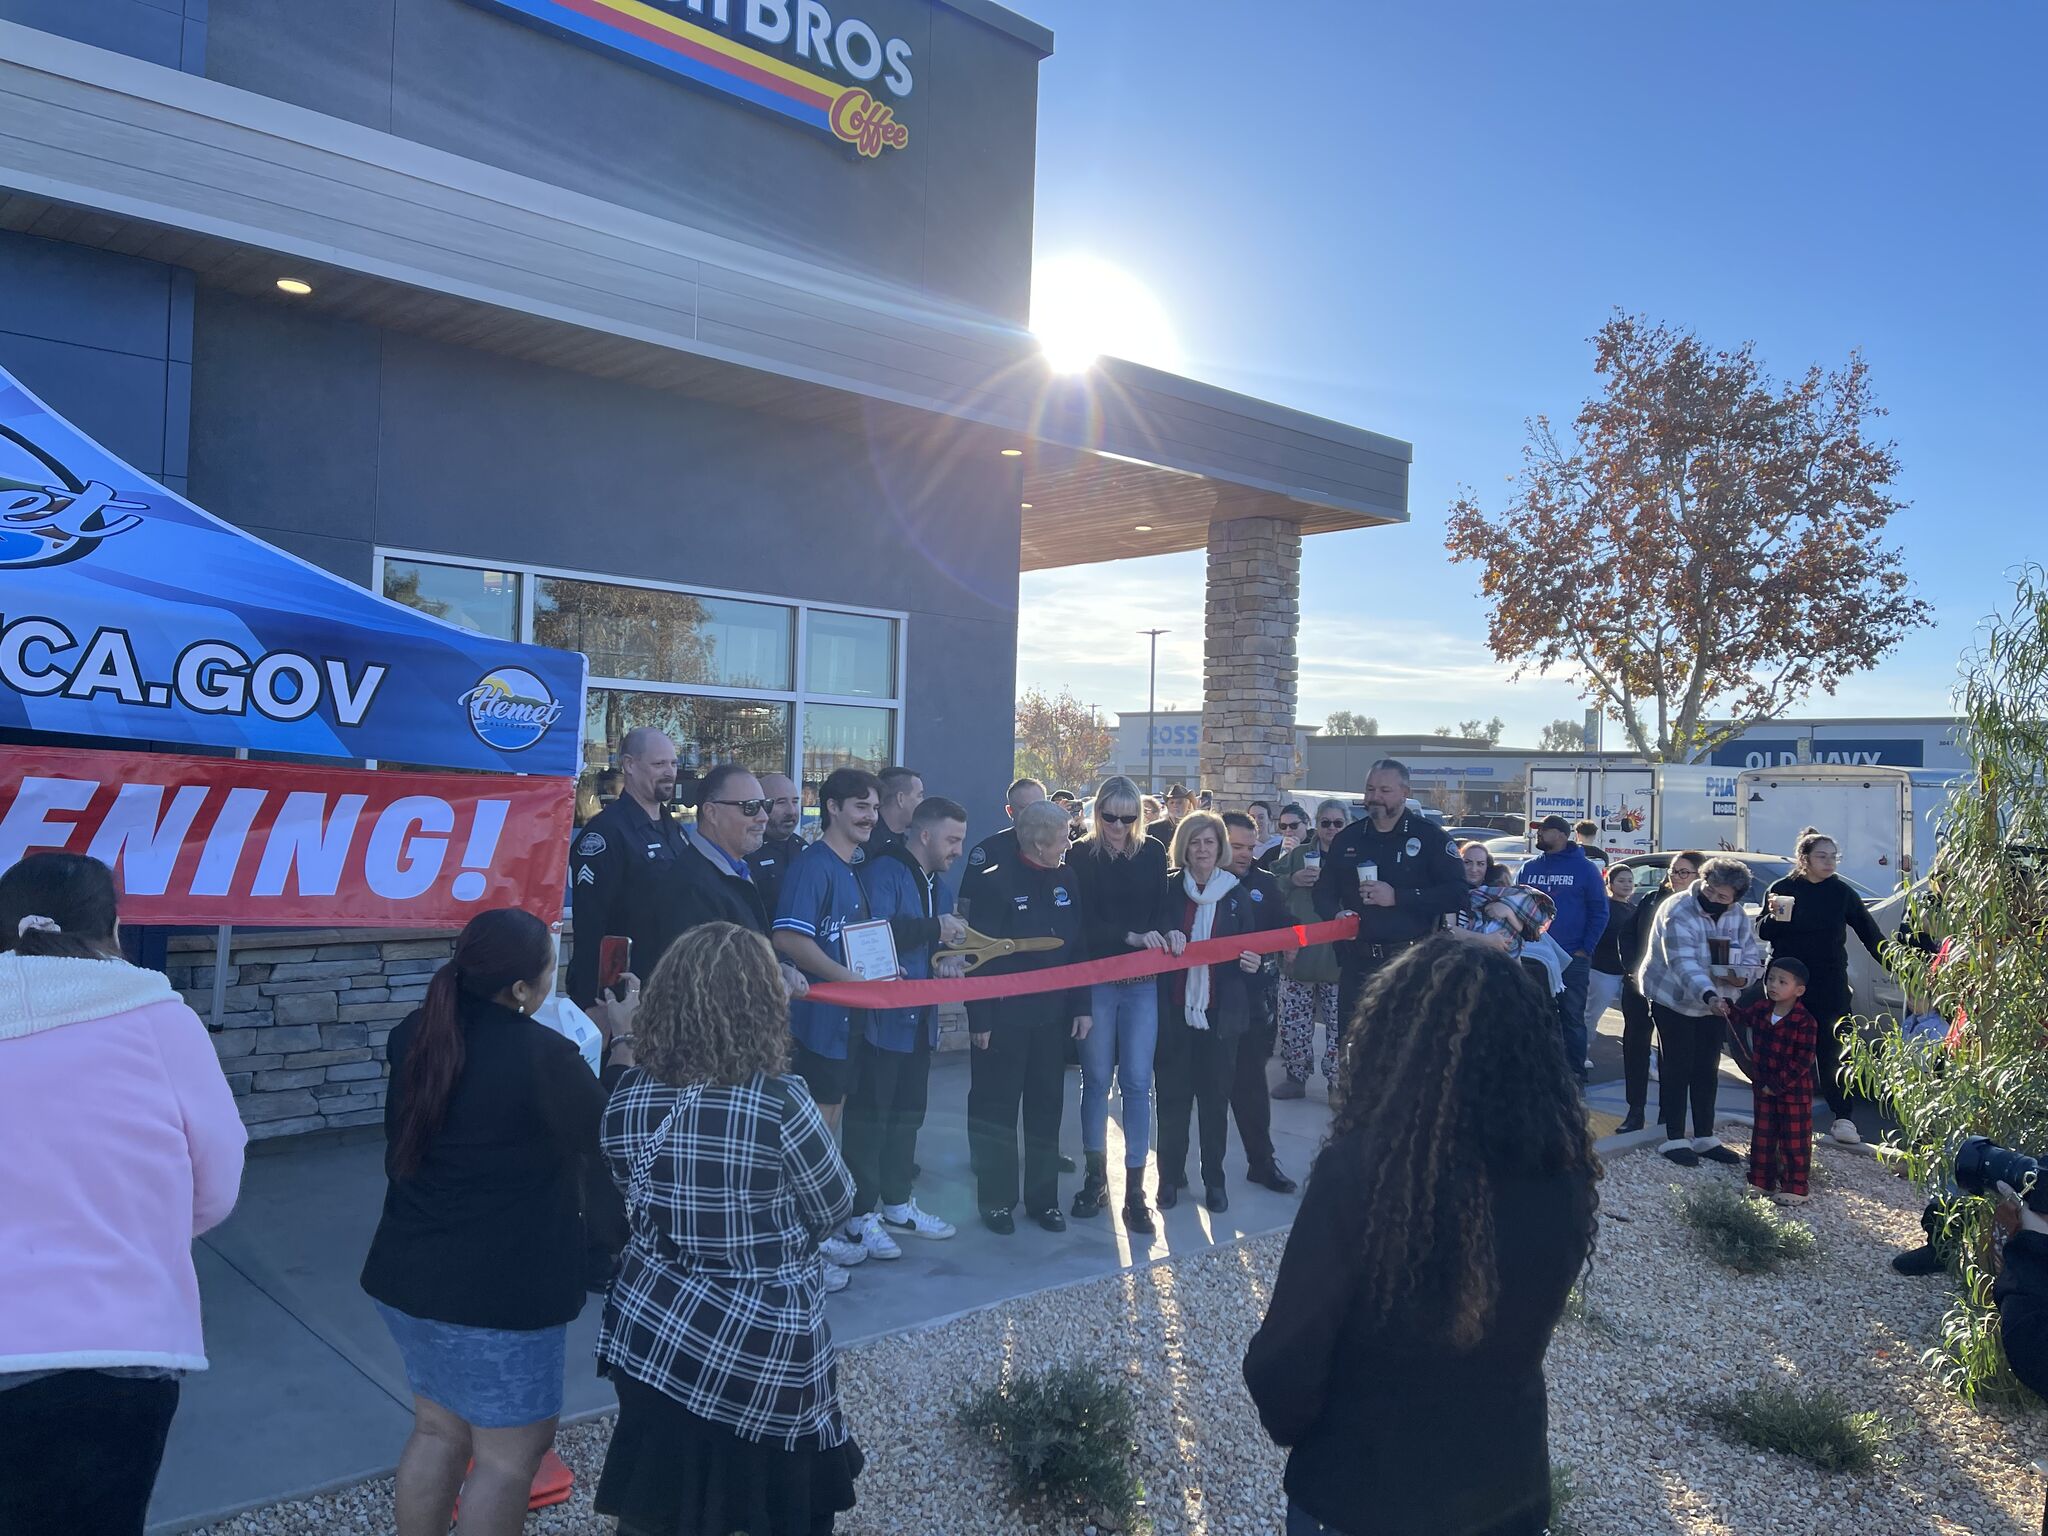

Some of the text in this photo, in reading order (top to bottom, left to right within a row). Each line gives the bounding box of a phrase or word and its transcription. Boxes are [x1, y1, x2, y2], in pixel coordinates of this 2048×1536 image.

[745, 0, 914, 97] BROS
[829, 88, 909, 157] Coffee
[457, 684, 564, 724] Hemet
[1745, 751, 1882, 769] OLD NAVY
[1527, 874, 1574, 886] LA CLIPPERS
